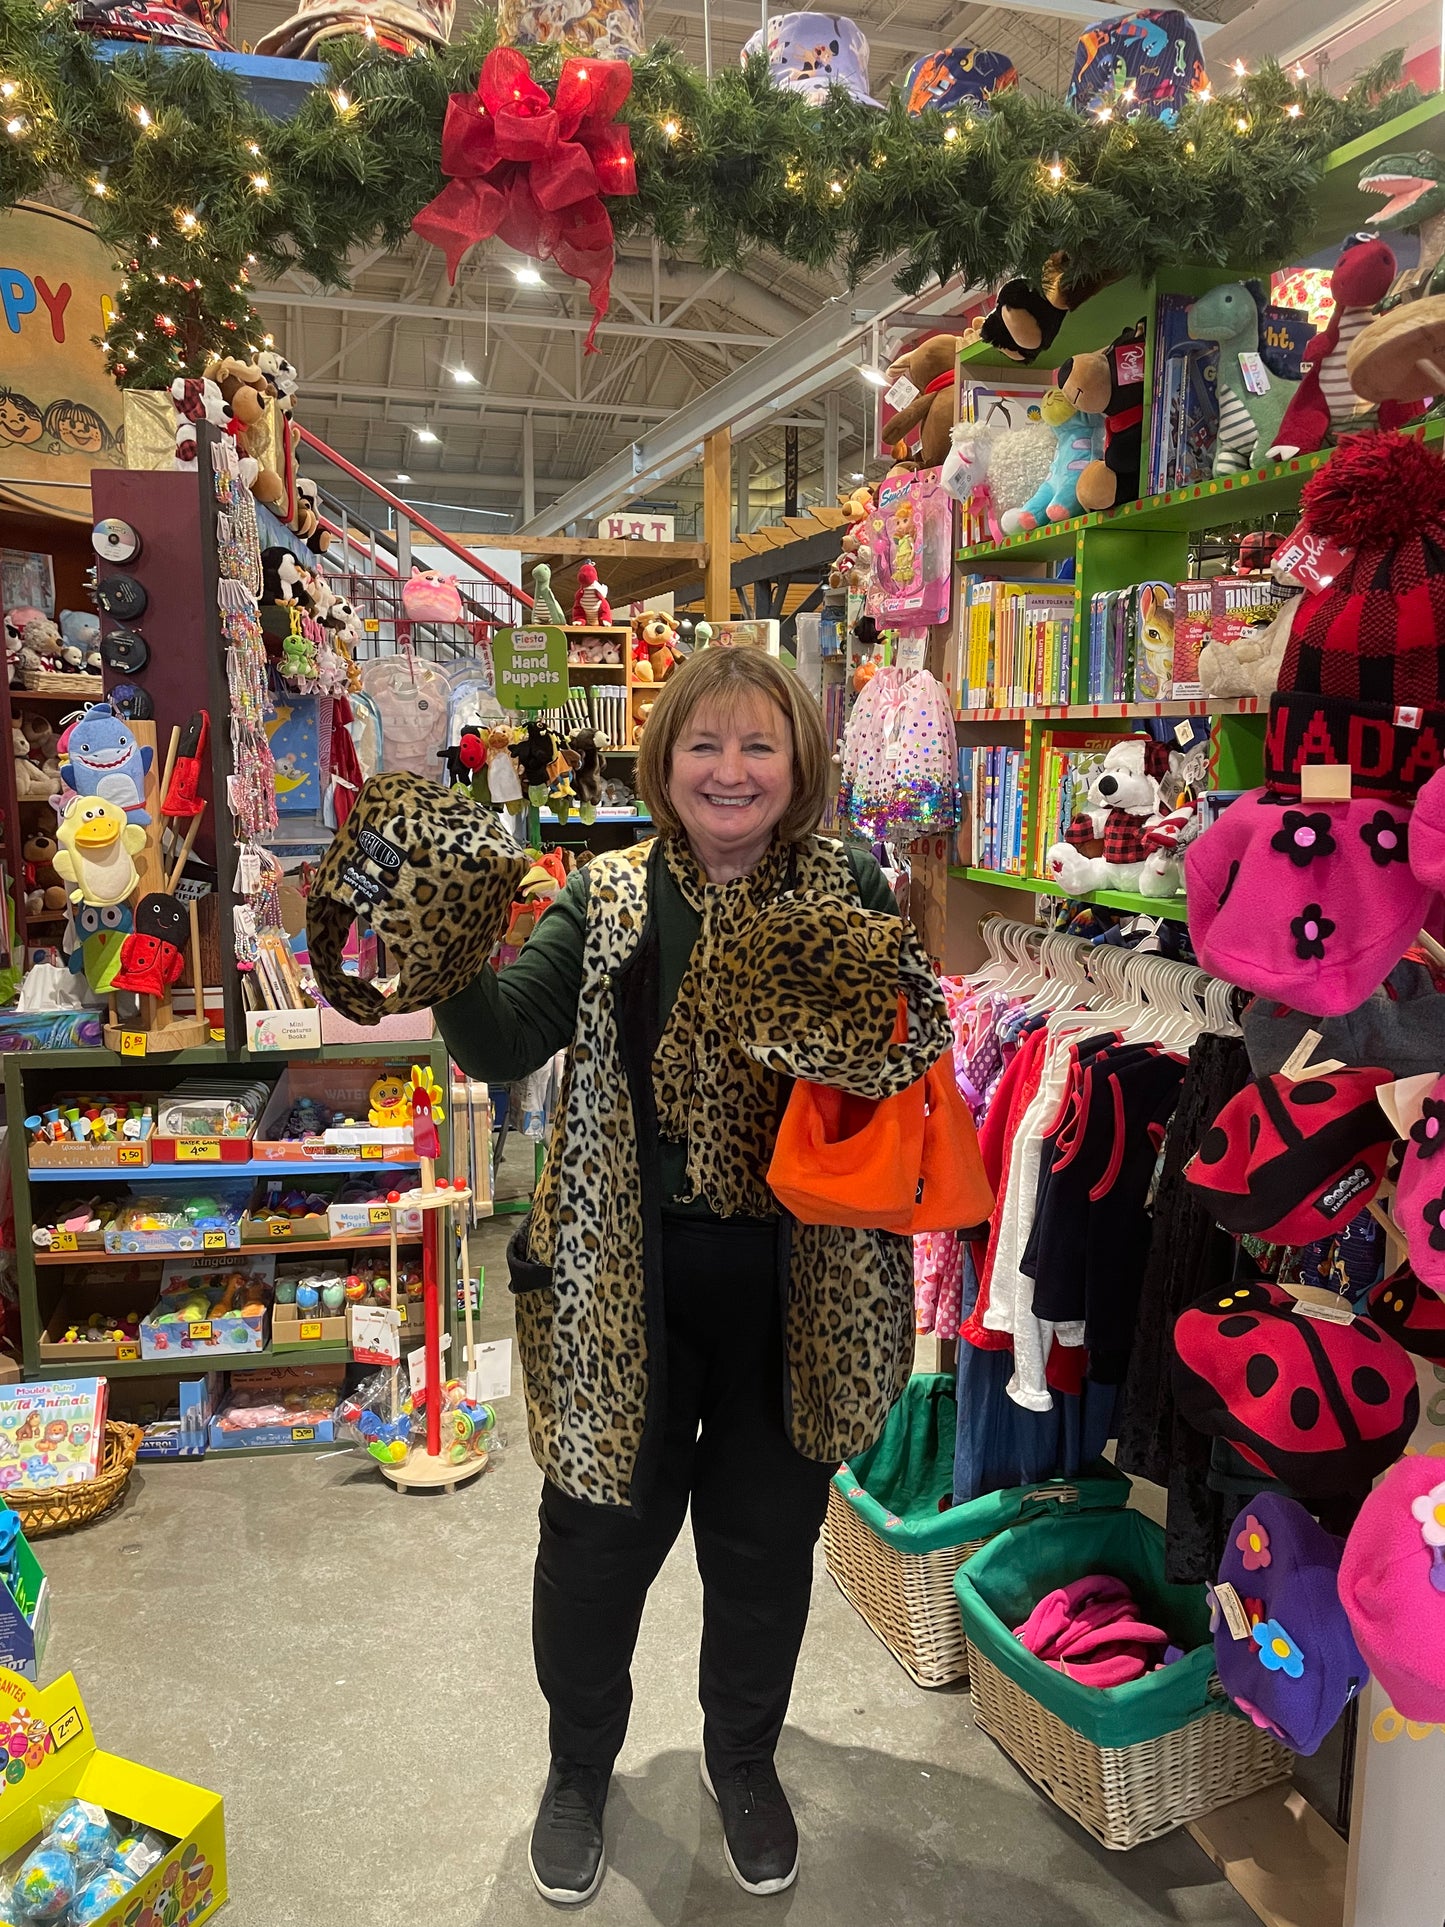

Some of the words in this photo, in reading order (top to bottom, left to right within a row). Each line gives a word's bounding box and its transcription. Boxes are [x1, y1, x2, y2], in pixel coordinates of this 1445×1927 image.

[514, 634, 544, 644] Fiesta
[511, 653, 548, 669] Hand
[502, 670, 560, 688] Puppets
[361, 832, 397, 865] GREMLINS
[342, 874, 359, 887] HAPPY
[357, 884, 374, 899] WEAR
[1331, 1190, 1353, 1213] HAPPY
[1350, 1177, 1371, 1194] WEAR
[340, 1213, 366, 1221] Magic
[192, 1256, 246, 1268] Kingdom
[0, 1398, 32, 1412] Wild
[34, 1394, 91, 1409] Animals
